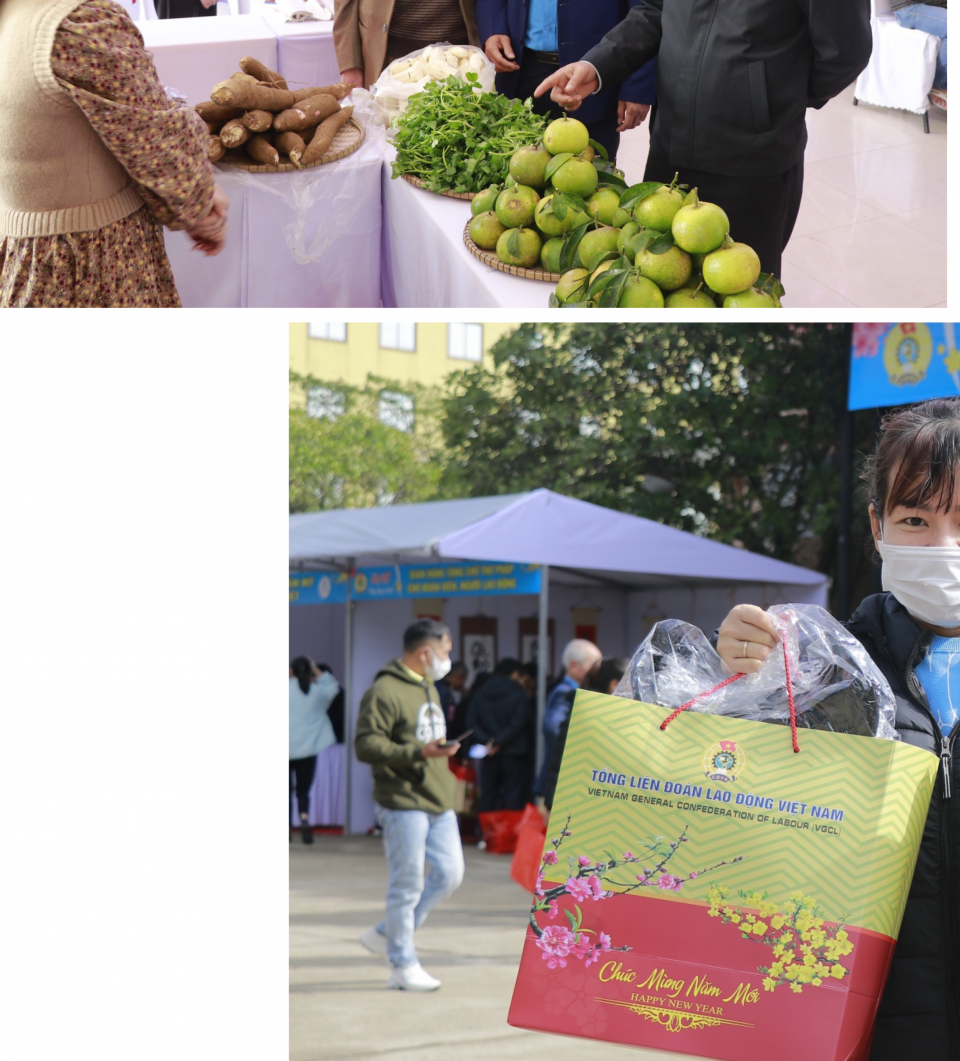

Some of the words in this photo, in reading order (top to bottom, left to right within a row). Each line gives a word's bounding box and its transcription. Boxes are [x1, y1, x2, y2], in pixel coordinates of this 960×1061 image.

[587, 787, 629, 801] VIETNAM
[631, 794, 674, 809] GENERAL
[676, 801, 755, 821] CONFEDERATION
[757, 814, 770, 823] OF
[771, 816, 810, 831] LABOUR
[811, 823, 842, 837] (VGCL)
[591, 767, 626, 786] TỔNG
[630, 775, 660, 791] LIÊN
[664, 781, 702, 797] ĐOÀN
[705, 789, 731, 803] LAO
[735, 792, 774, 810] ĐỘNG
[778, 799, 808, 815] VIỆT
[810, 806, 845, 822] NAM
[598, 960, 638, 983] Chúc
[636, 967, 684, 998] Mừng
[688, 974, 723, 998] Năm
[722, 981, 761, 1006] Mới
[630, 992, 667, 1008] HAPPY
[668, 999, 693, 1012] NEW
[693, 1003, 724, 1016] YEAR
